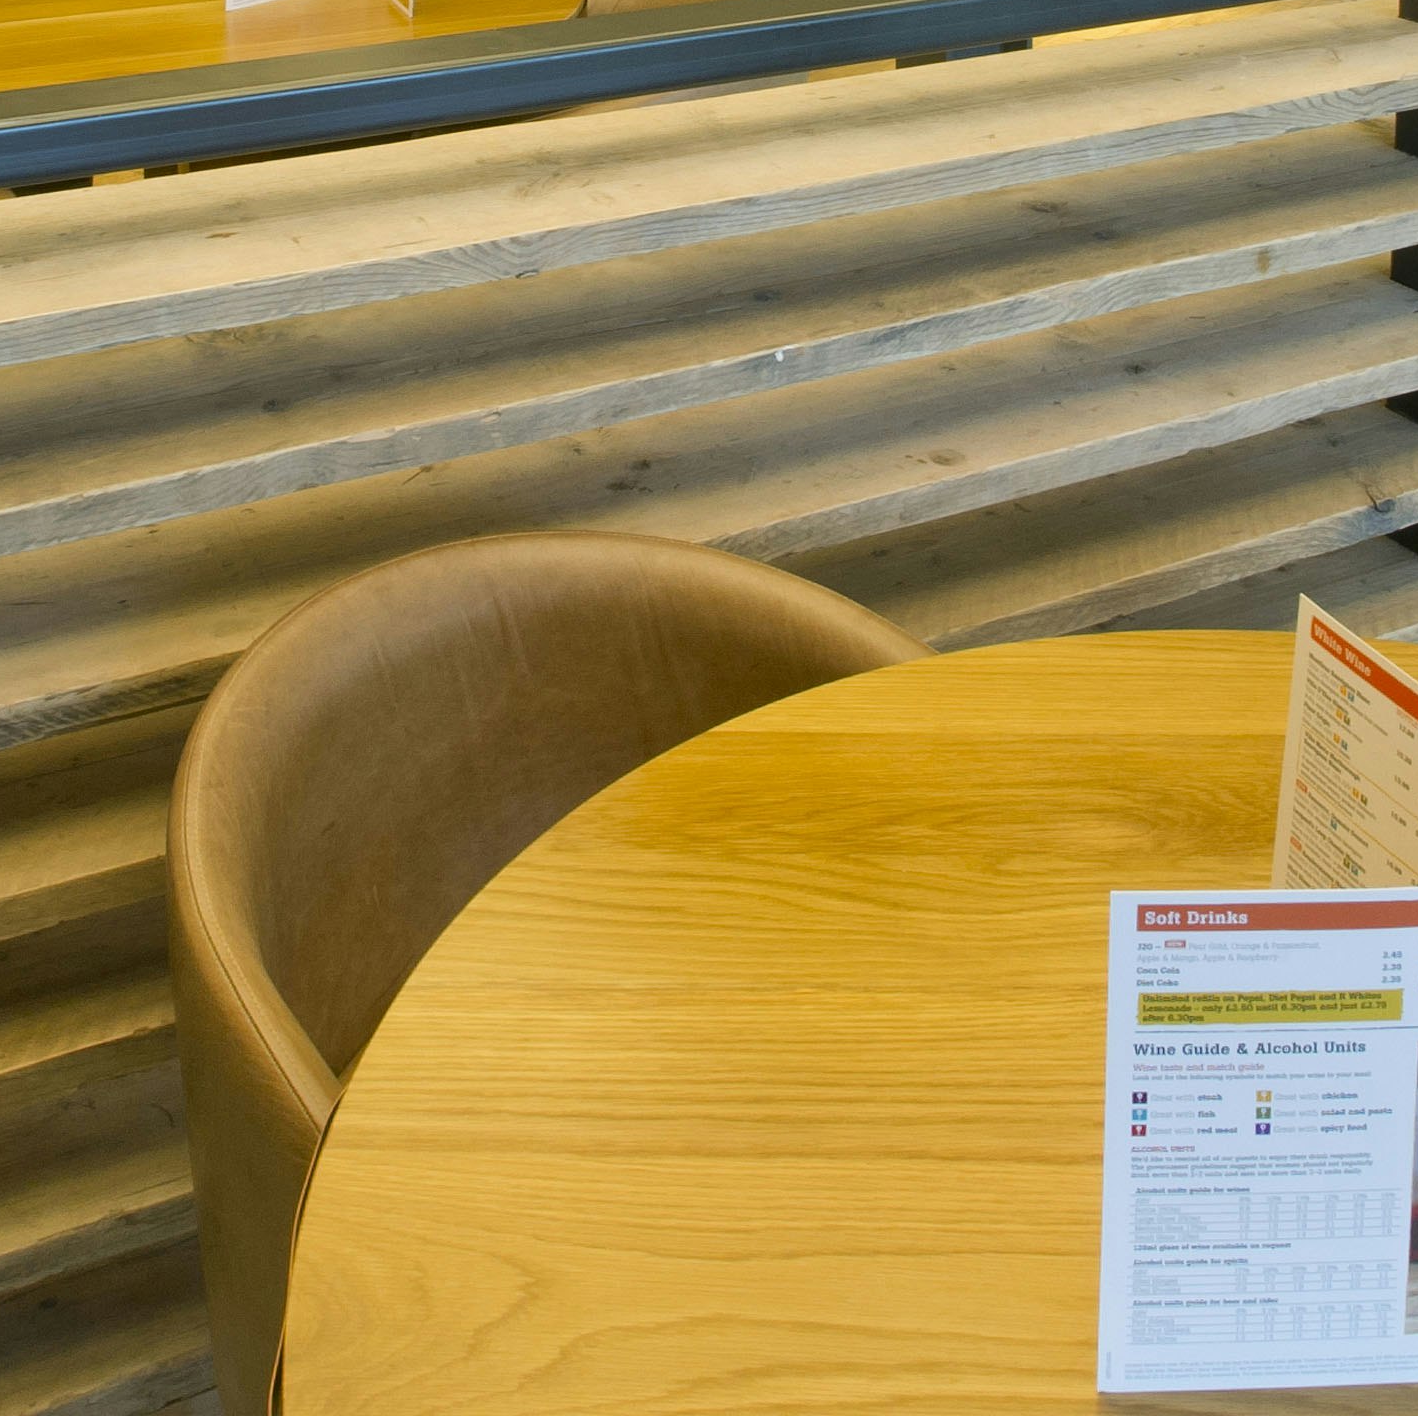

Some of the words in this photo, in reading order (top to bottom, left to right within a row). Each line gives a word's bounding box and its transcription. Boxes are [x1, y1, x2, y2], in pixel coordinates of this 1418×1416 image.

[1314, 624, 1343, 655] White
[1345, 648, 1372, 677] Wine
[1144, 910, 1181, 926] Soft
[1187, 910, 1249, 925] Drinks
[1133, 1043, 1176, 1056] Wine
[1182, 1042, 1231, 1056] Guide
[1236, 1042, 1249, 1056] &
[1255, 1041, 1318, 1055] Alcohol
[1324, 1040, 1367, 1054] Units
[1133, 1063, 1158, 1072] Wine
[1185, 1063, 1204, 1071] and
[1206, 1062, 1236, 1071] match
[1237, 1062, 1265, 1073] guide
[1197, 1110, 1216, 1119] fish
[1196, 1126, 1213, 1134] red
[1214, 1126, 1238, 1134] meat
[1320, 1125, 1345, 1133] spicy
[1347, 1122, 1367, 1131] food
